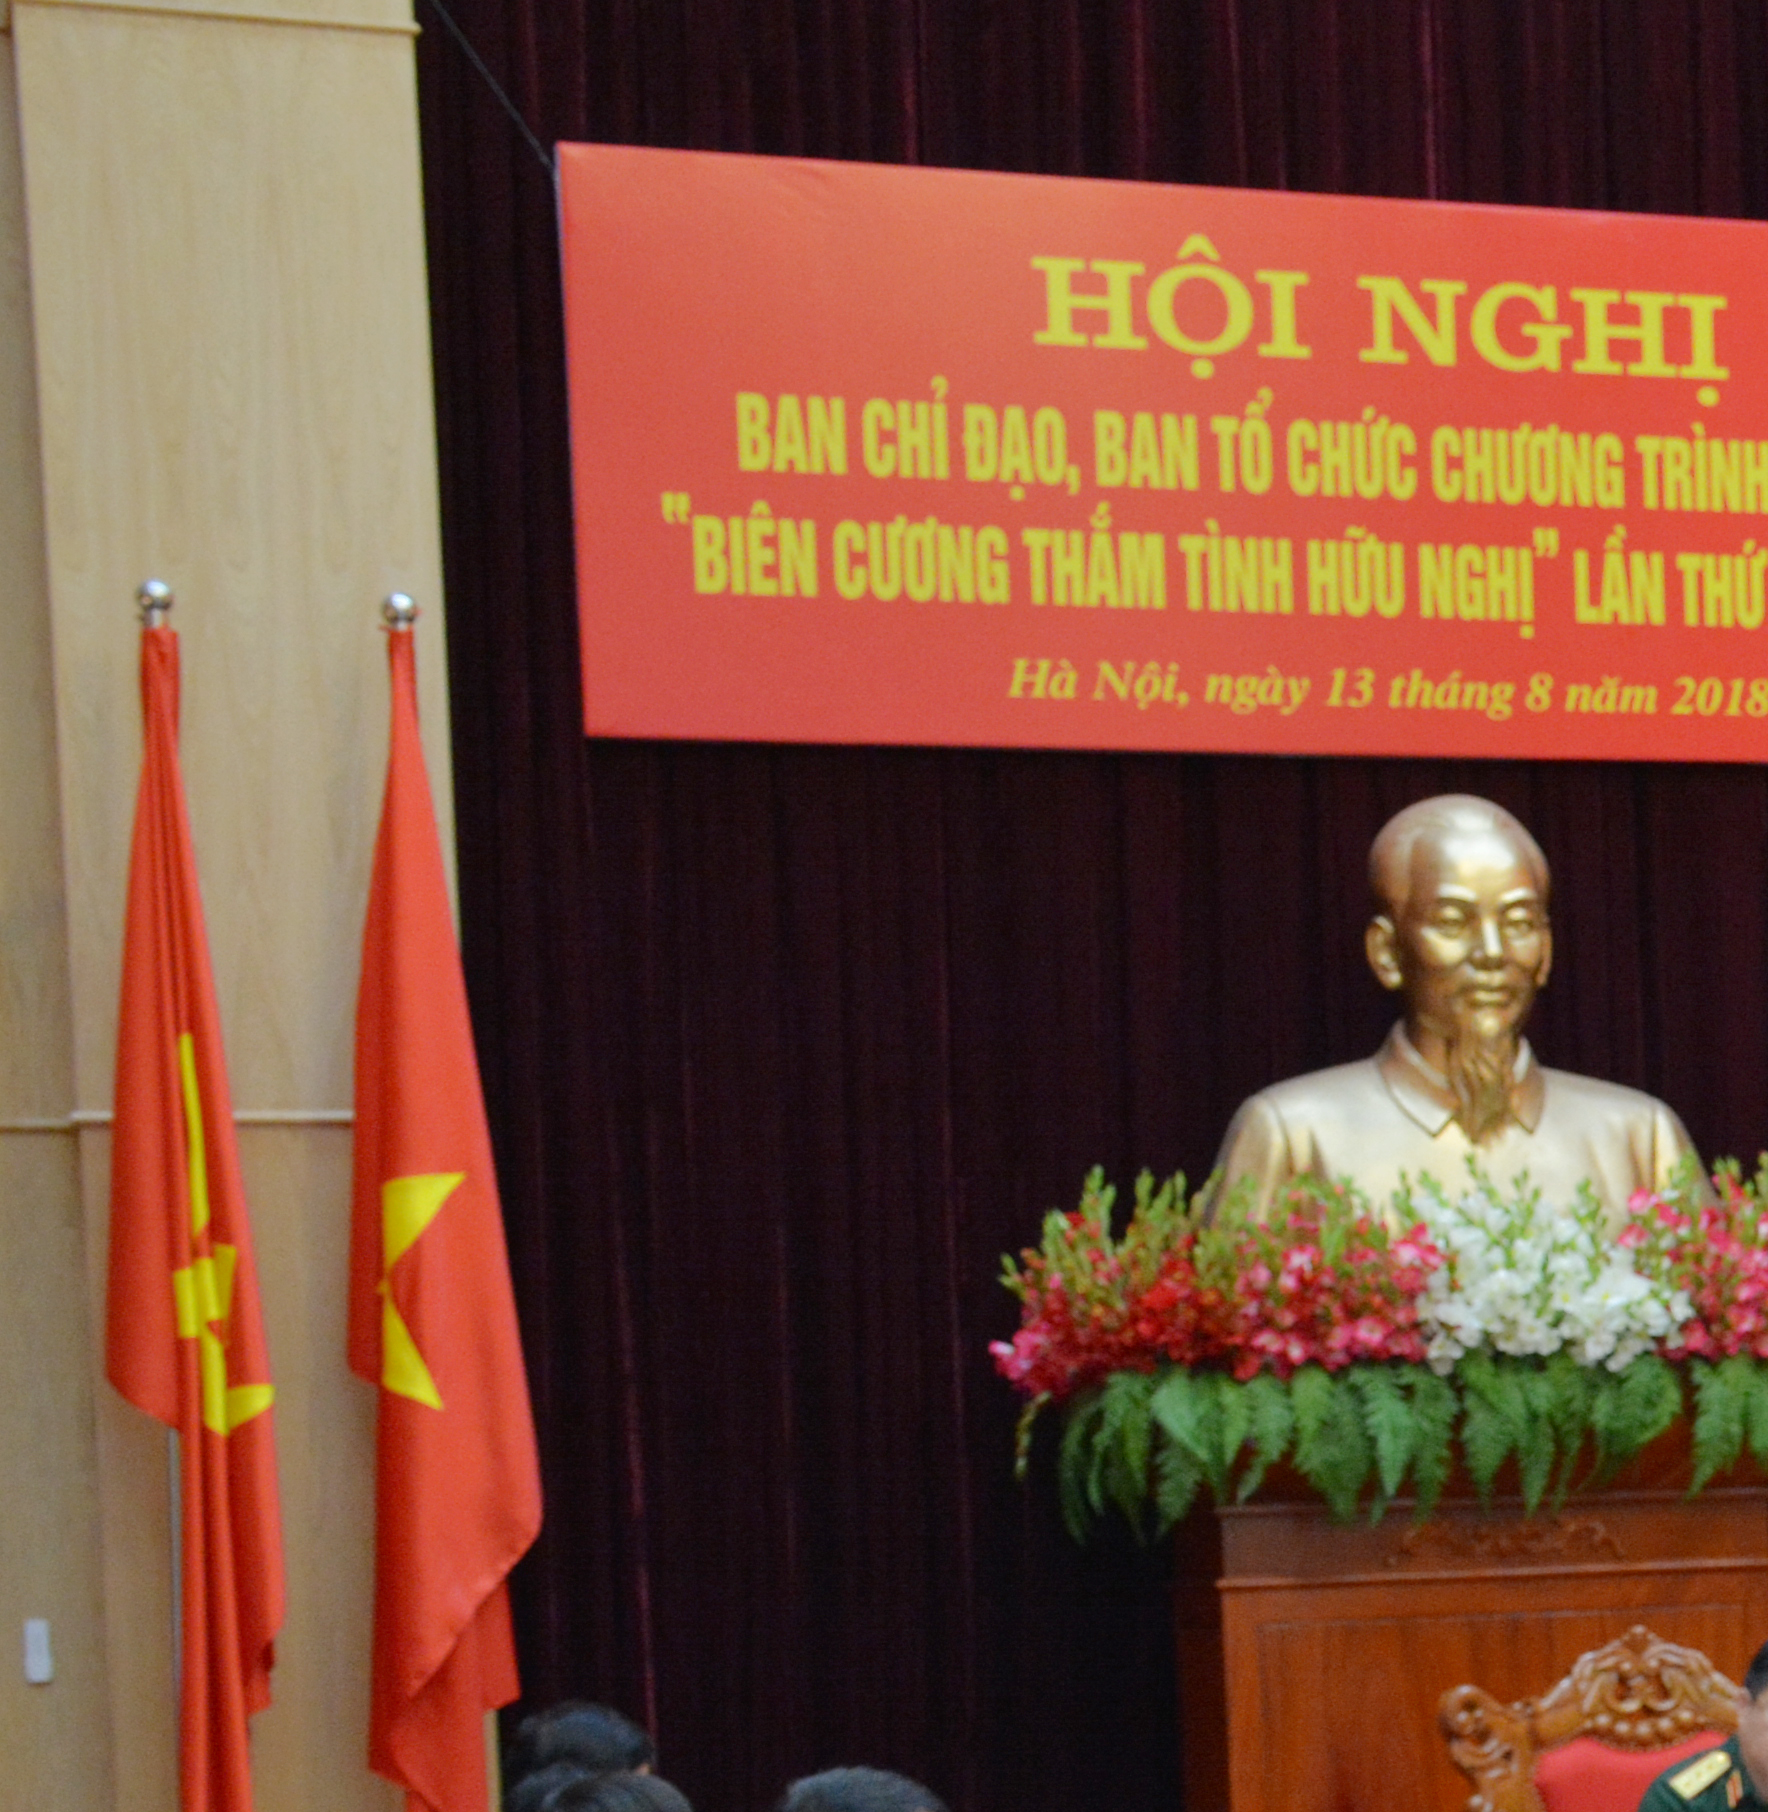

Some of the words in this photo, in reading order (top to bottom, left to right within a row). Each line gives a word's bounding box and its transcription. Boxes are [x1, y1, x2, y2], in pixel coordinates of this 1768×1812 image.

[1030, 233, 1312, 380] HỘI
[1356, 275, 1730, 407] NGHỊ
[736, 392, 848, 476] BAN
[861, 375, 950, 480] CHỈ
[962, 403, 1082, 501] ĐẠO,
[1093, 409, 1200, 491] BAN
[1210, 387, 1273, 495] TỔ
[1286, 406, 1418, 501] CHỨC
[1431, 418, 1625, 509] CHƯƠNG
[832, 514, 1011, 605] CƯƠNG
[1021, 501, 1167, 610] THẮM
[1177, 518, 1294, 615] TÌNH
[1306, 525, 1406, 618] HỮU
[1573, 524, 1666, 626] LẦN
[1008, 657, 1078, 700] Hà
[1098, 659, 1190, 711] Nội,
[1204, 665, 1311, 716] ngày
[1327, 668, 1376, 708] 13
[1388, 669, 1516, 720] tháng
[1525, 673, 1554, 712] 8
[1564, 677, 1659, 715] năm
